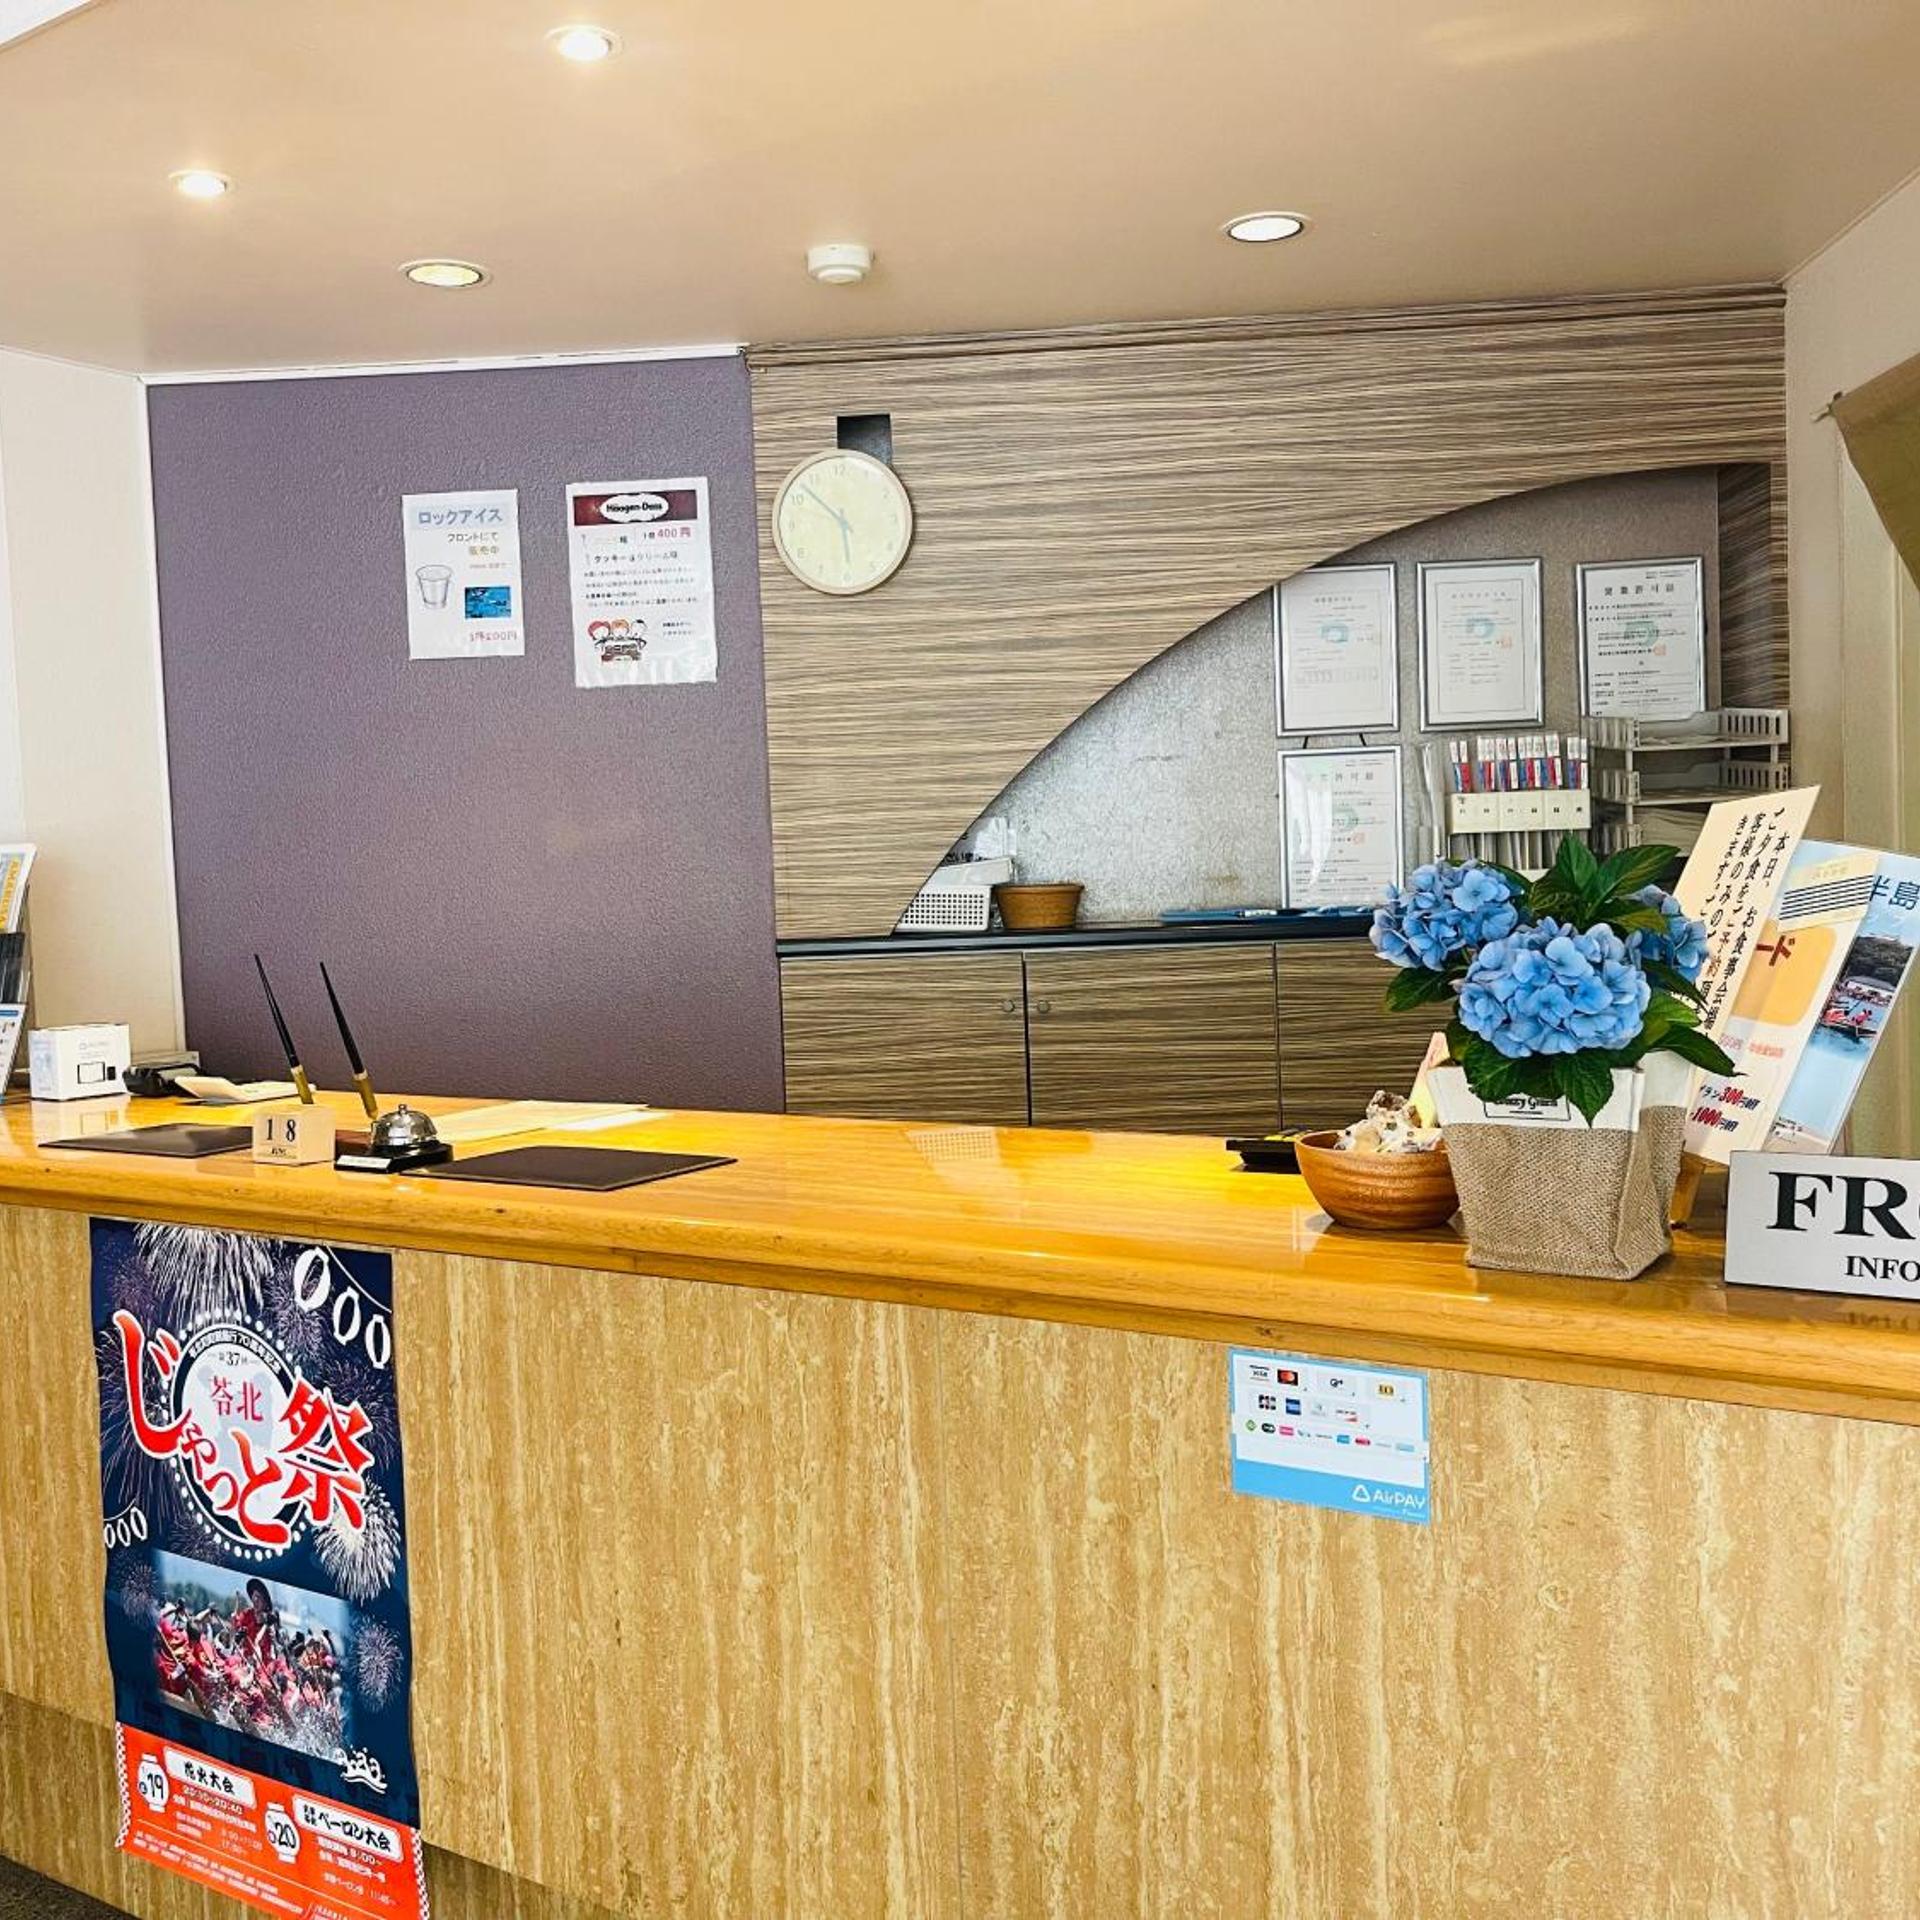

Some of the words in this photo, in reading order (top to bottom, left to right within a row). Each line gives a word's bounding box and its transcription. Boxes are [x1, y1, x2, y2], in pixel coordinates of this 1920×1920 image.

[418, 508, 502, 526] ロックアイス
[447, 531, 499, 543] フロントにて
[1703, 832, 1789, 1036] 本日、お食事会場
[1766, 1171, 1920, 1240] FR
[1844, 1255, 1920, 1282] INFO
[1373, 1489, 1426, 1510] AirPAY
[147, 1772, 164, 1800] 19
[275, 1821, 297, 1849] 20
